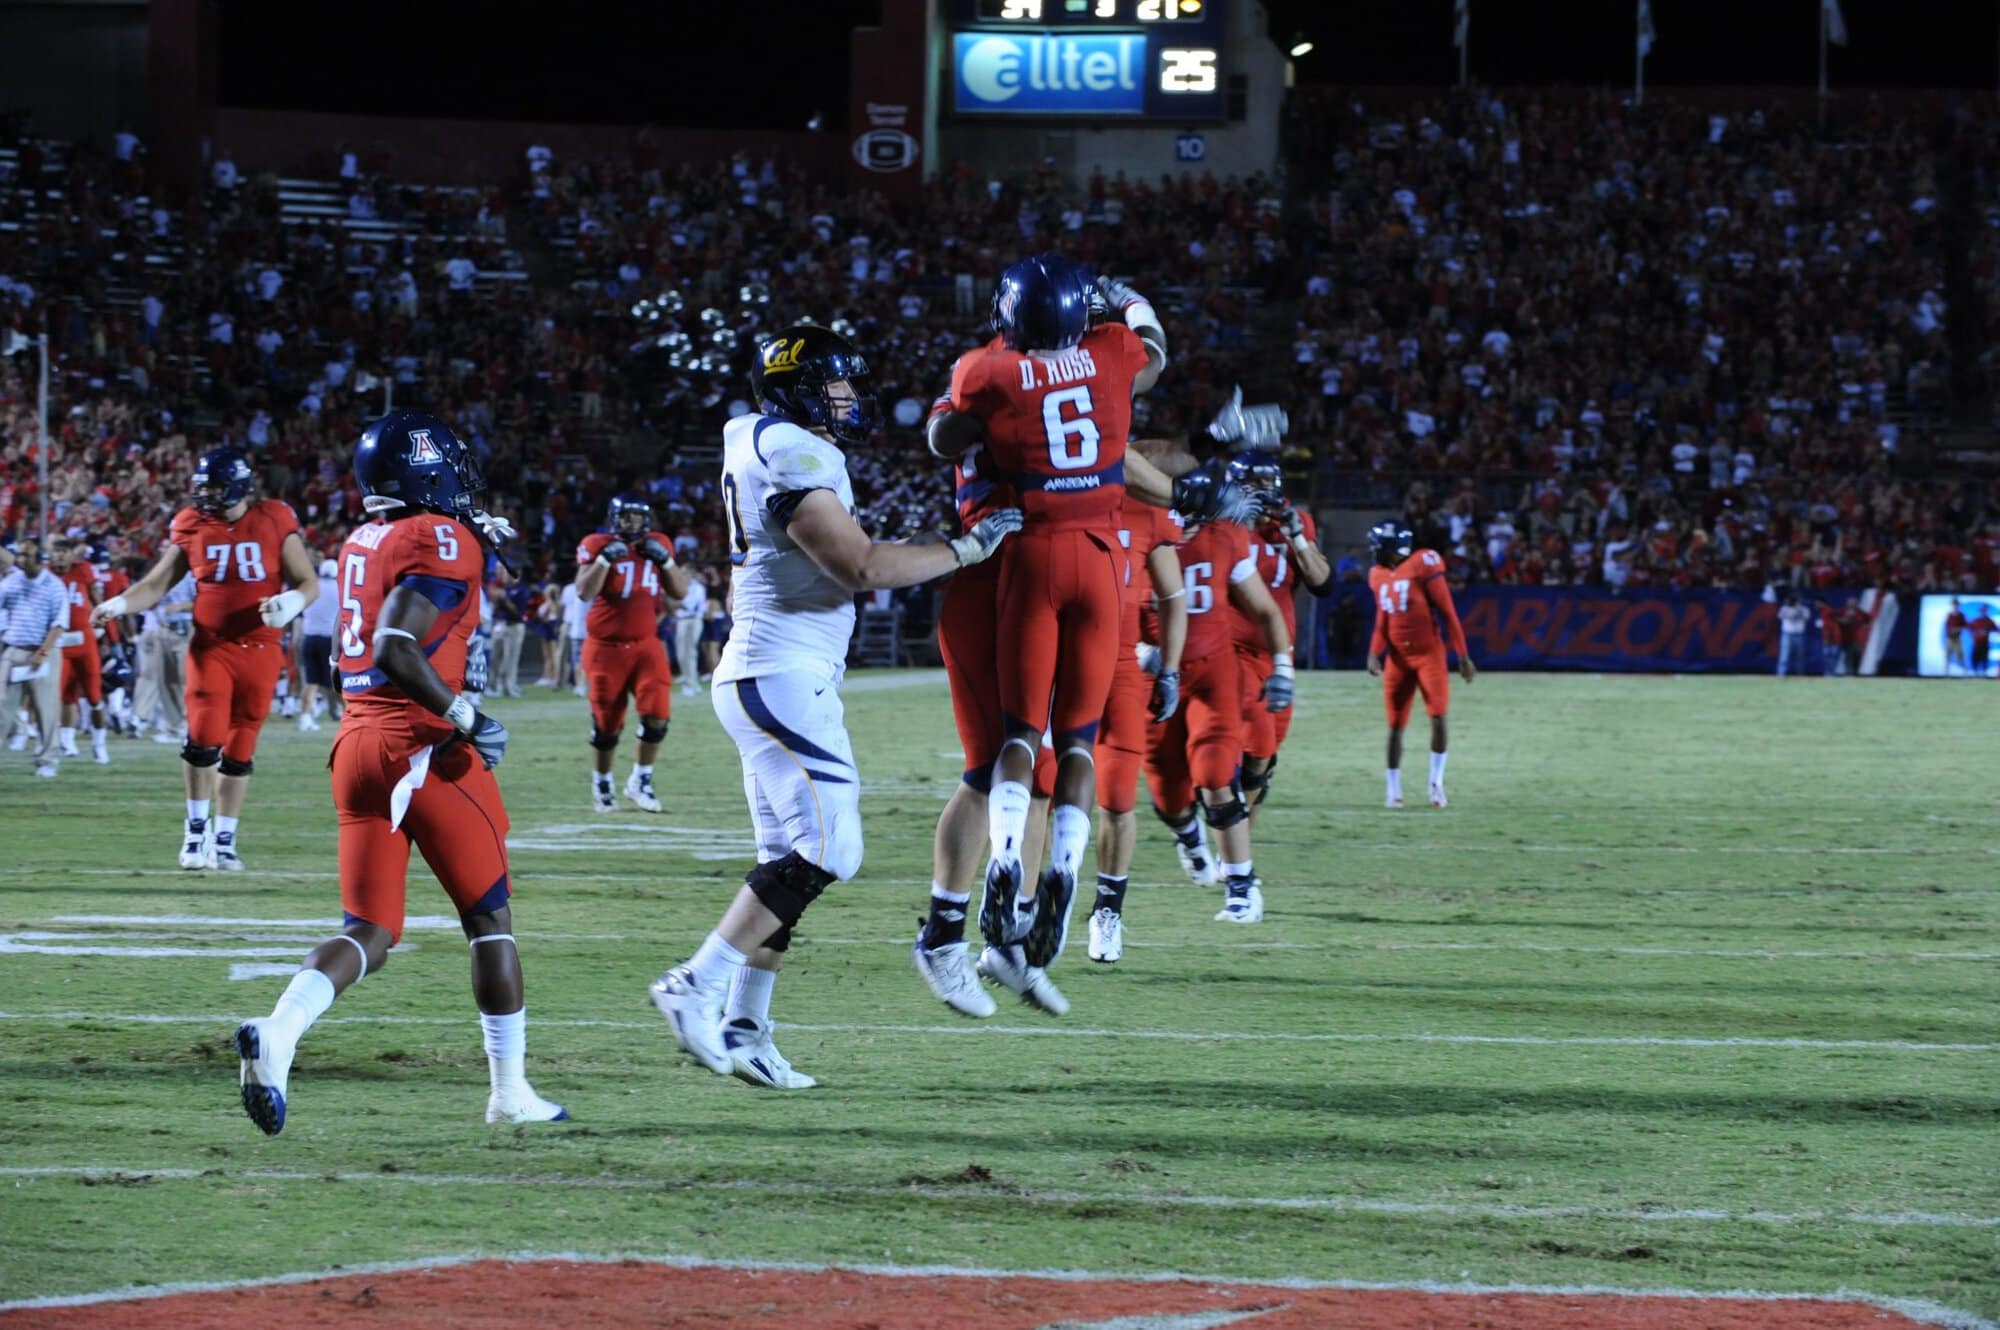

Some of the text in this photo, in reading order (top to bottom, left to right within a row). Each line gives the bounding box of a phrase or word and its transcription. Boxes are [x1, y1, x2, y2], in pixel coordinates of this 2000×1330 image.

[964, 37, 1136, 100] alltel
[763, 338, 806, 367] Cal
[1019, 359, 1043, 390] D.
[1043, 384, 1100, 470] 6
[408, 429, 442, 466] A
[206, 541, 266, 582] 78
[433, 523, 458, 561] 5
[616, 560, 658, 599] 74
[1380, 579, 1410, 614] 47
[342, 552, 367, 658] 5
[1459, 597, 1778, 658] ARIZONA
